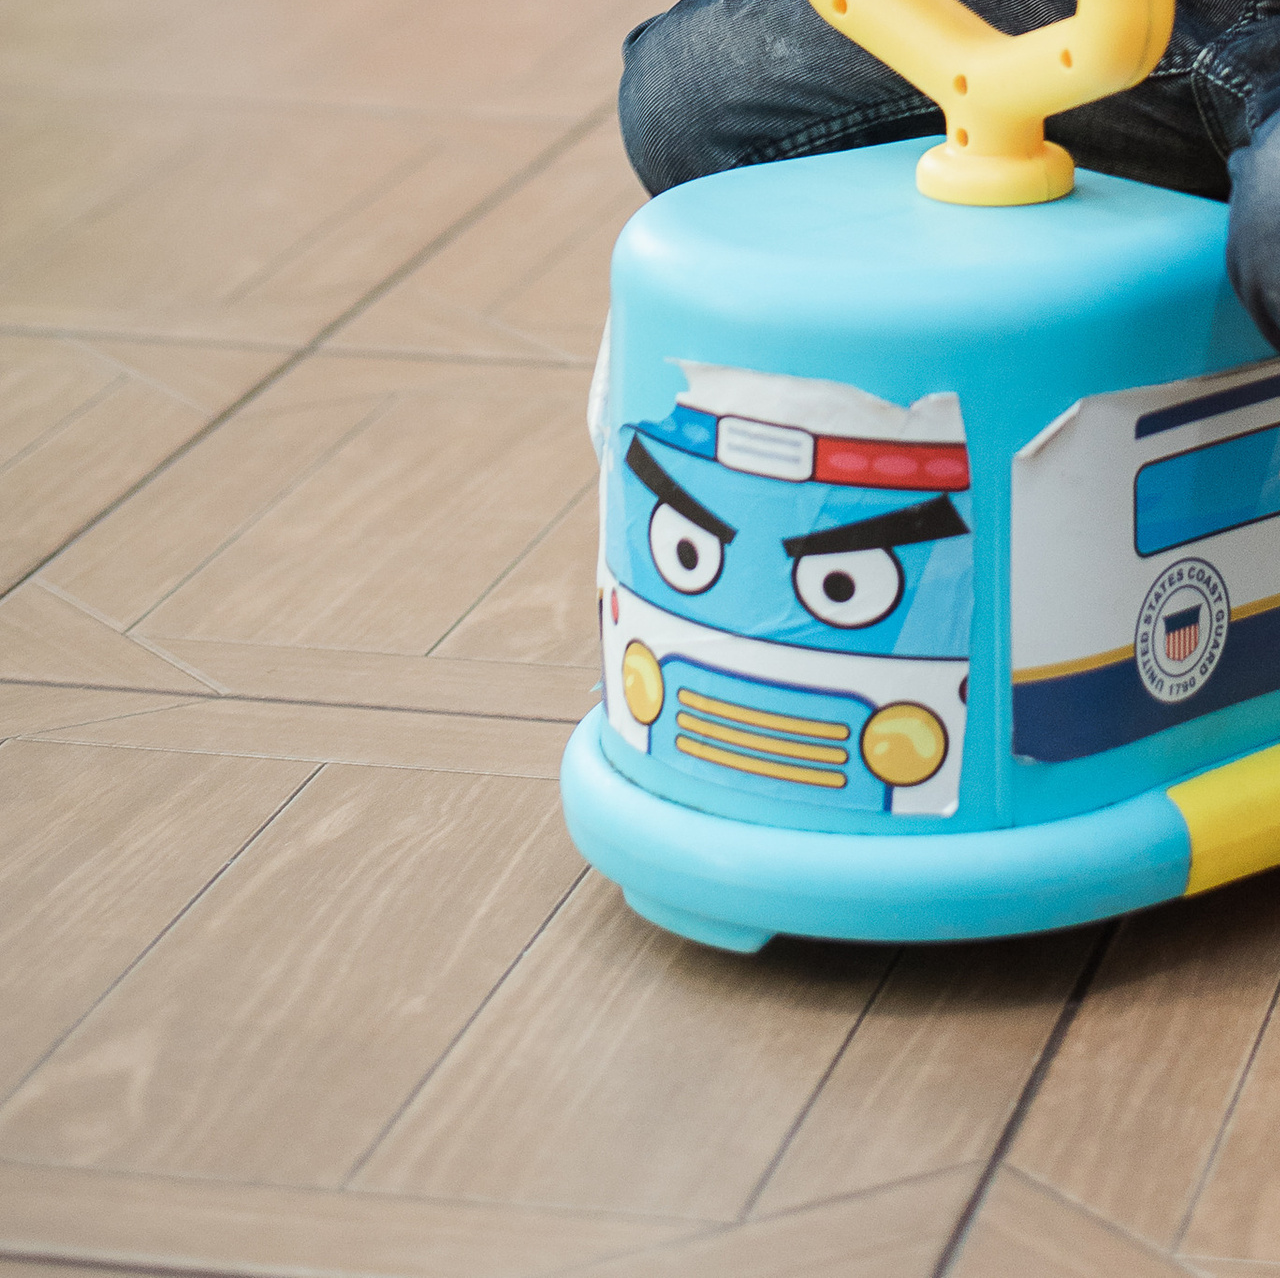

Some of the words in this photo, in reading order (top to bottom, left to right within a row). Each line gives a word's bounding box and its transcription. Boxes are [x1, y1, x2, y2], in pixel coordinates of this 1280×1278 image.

[1143, 567, 1185, 626] STATES
[1187, 566, 1223, 605] COAST
[1140, 631, 1165, 692] UNITED
[1199, 609, 1225, 676] GUARD
